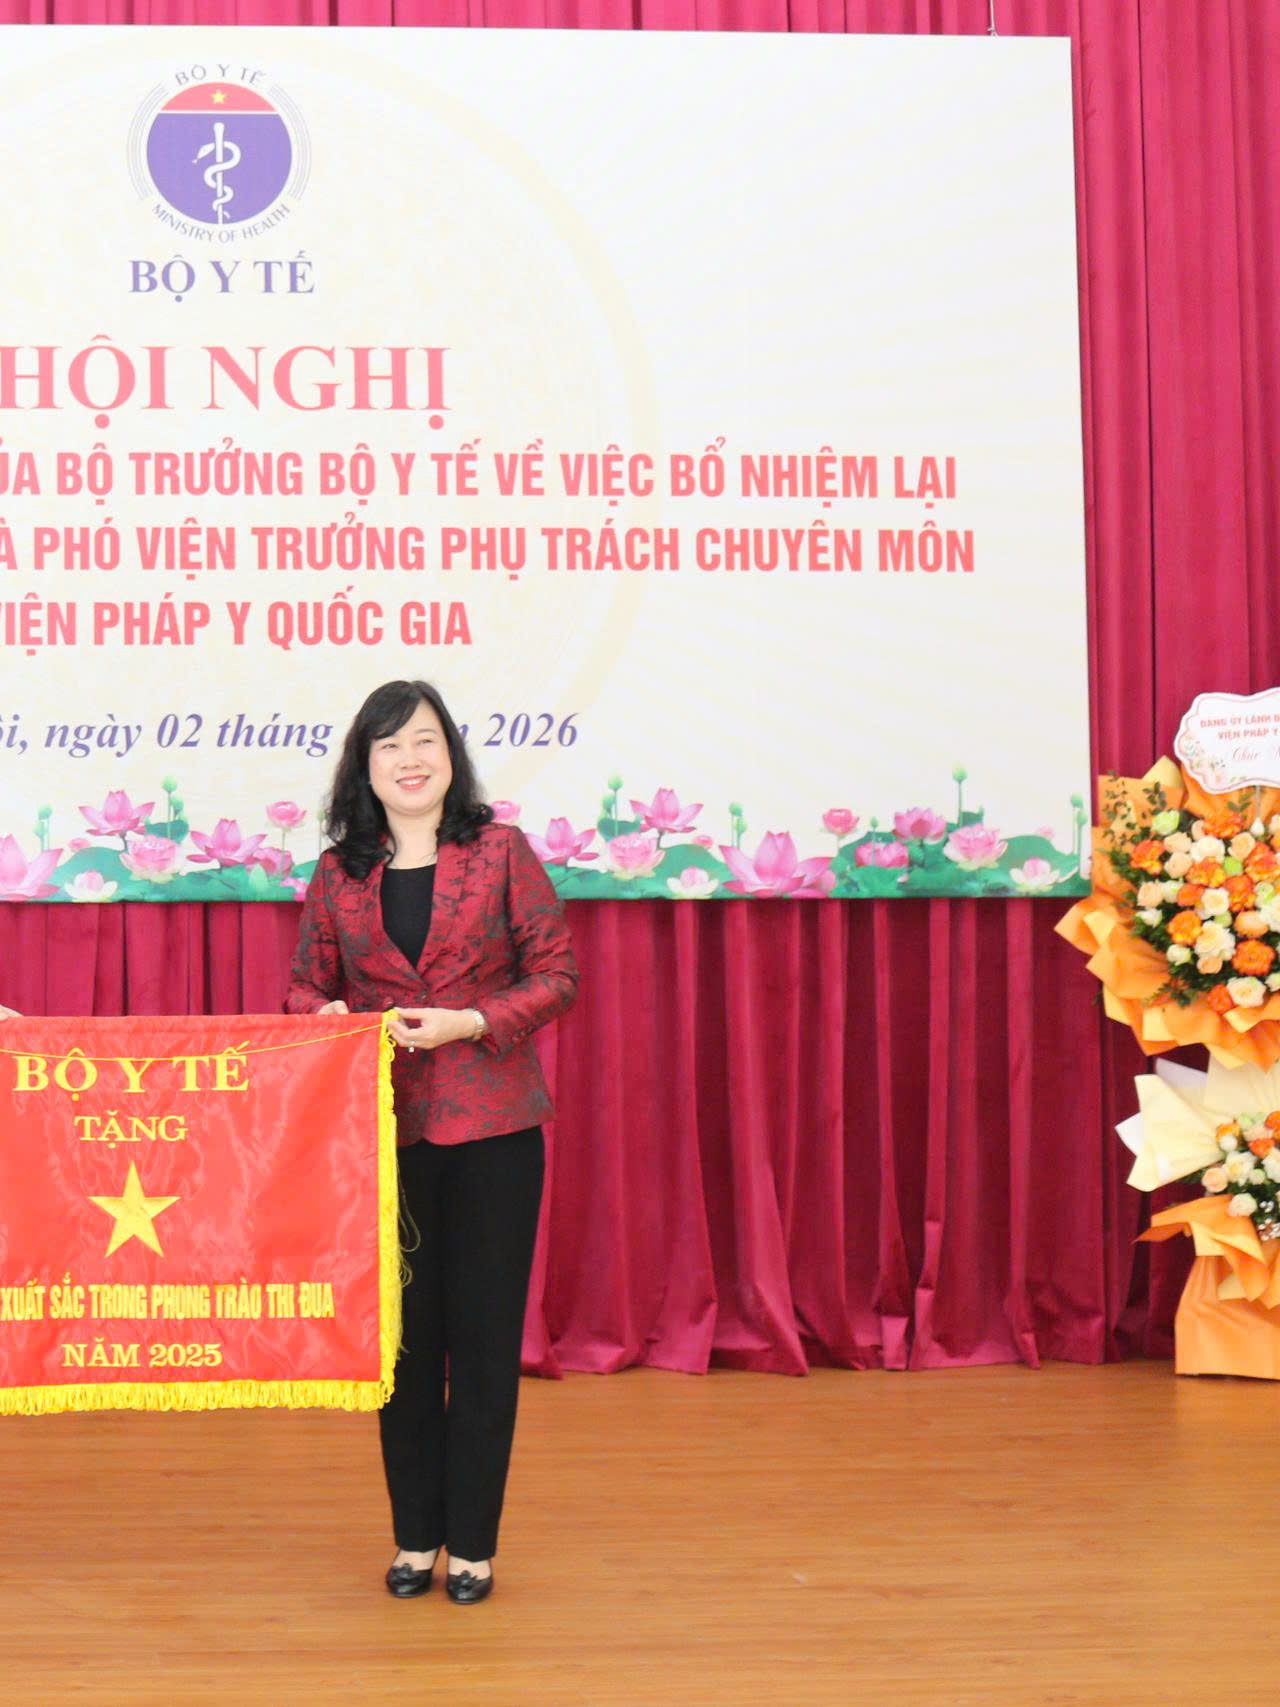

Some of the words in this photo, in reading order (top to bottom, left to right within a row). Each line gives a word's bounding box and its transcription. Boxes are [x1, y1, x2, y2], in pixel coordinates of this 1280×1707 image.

[218, 63, 231, 78] Y
[152, 203, 213, 242] MINISTRY
[218, 230, 238, 243] OF
[242, 203, 291, 240] HEALTH
[129, 254, 195, 302] BỘ
[209, 260, 241, 293] Y
[252, 250, 315, 293] TẾ
[201, 346, 452, 429] NGHỊ
[57, 443, 112, 505] BỘ
[129, 438, 302, 496] TRƯỞNG
[320, 443, 376, 505] BỘ
[392, 453, 416, 495] Y
[432, 440, 480, 496] TẾ
[495, 440, 544, 496] VỀ
[560, 445, 654, 506] VIỆC
[671, 437, 725, 496] BỔ
[741, 447, 878, 508] NHIỆM
[895, 456, 956, 508] LẠI
[34, 518, 120, 570] PHÓ
[136, 518, 236, 580] VIỆN
[251, 512, 424, 571] TRƯỞNG
[442, 528, 526, 580] PHỤ
[541, 518, 680, 571] TRÁCH
[696, 520, 862, 572] CHUYÊN
[879, 520, 974, 573] MÔN
[94, 592, 210, 645] PHÁP
[227, 602, 250, 645] Y
[268, 586, 383, 650] QUỐC
[400, 601, 472, 645] GIA
[45, 714, 142, 757] ngày
[157, 714, 202, 747] 02
[217, 714, 331, 757] tháng
[484, 713, 577, 747] 2026
[13, 1048, 98, 1101] BỘ
[117, 1057, 154, 1093] Y
[173, 1041, 249, 1092] TẾ
[74, 1111, 188, 1148] TẶNG
[0, 1280, 45, 1320] XUẤT
[50, 1272, 85, 1318] SẮC
[88, 1284, 148, 1319] TRONG
[151, 1285, 211, 1319] PHONG
[215, 1276, 262, 1319] TRÀO
[266, 1284, 295, 1318] THI
[298, 1283, 335, 1318] ĐUA
[61, 1338, 140, 1367] NĂM
[150, 1344, 222, 1367] 2025
